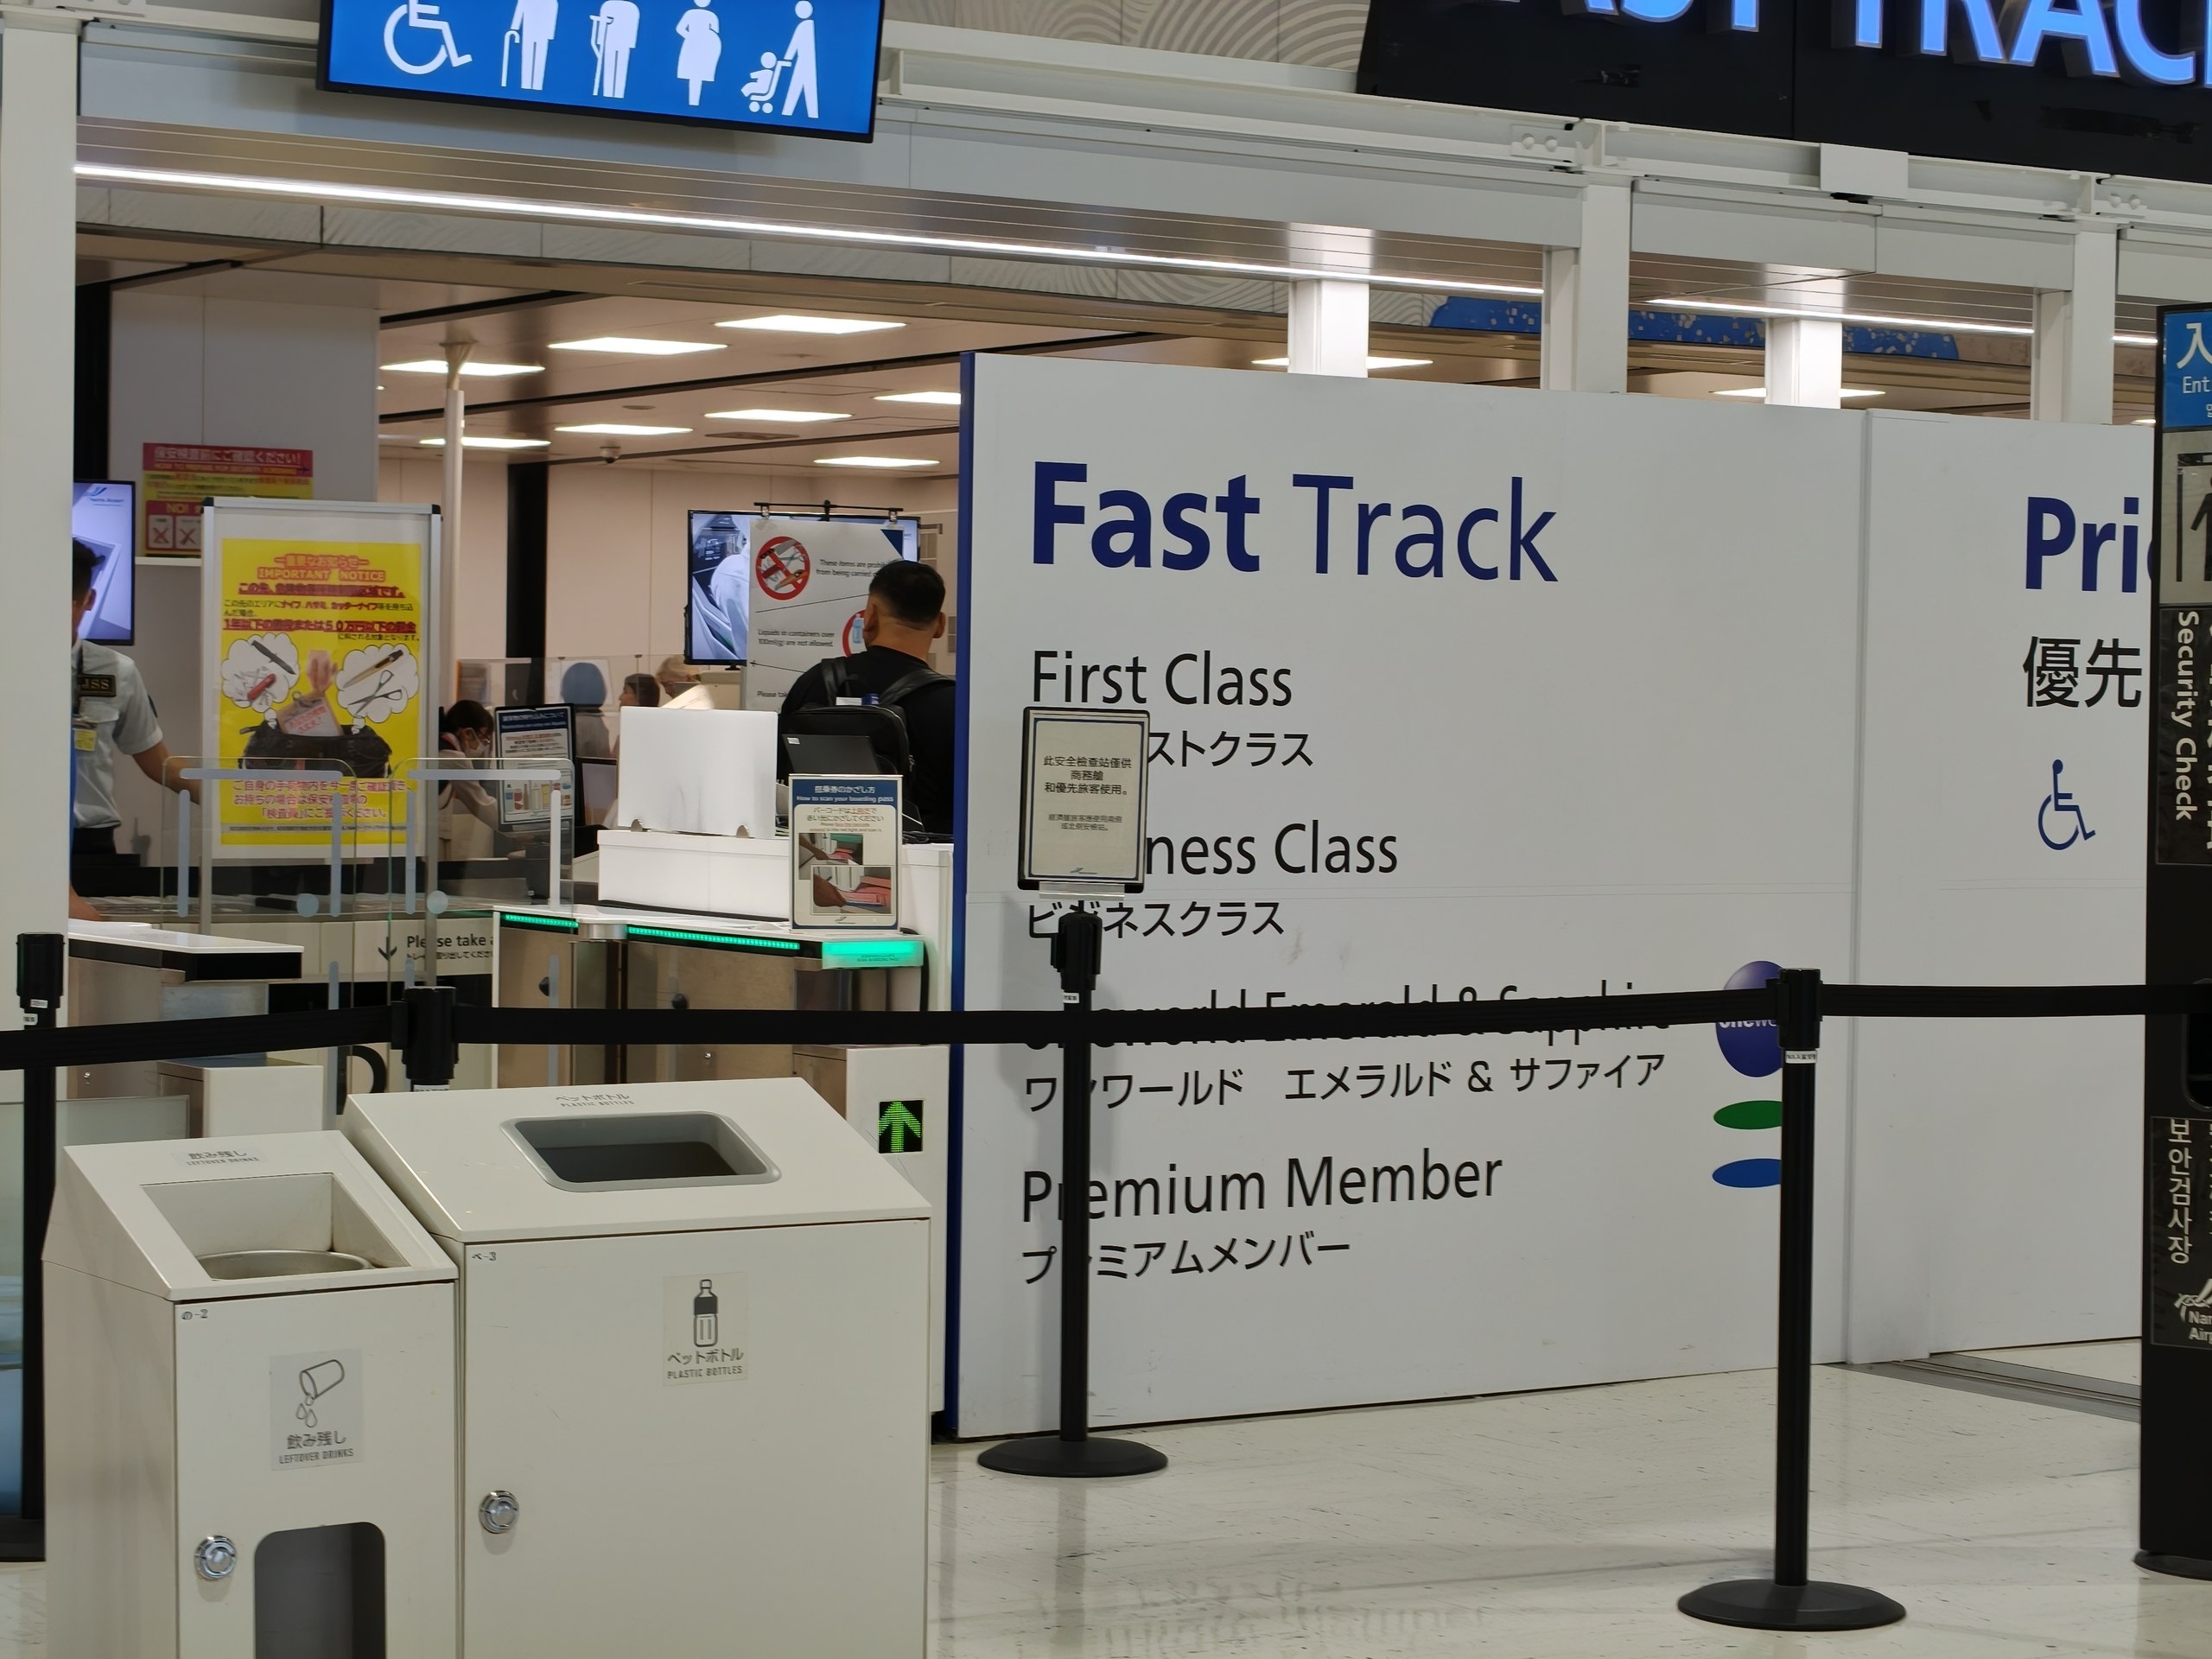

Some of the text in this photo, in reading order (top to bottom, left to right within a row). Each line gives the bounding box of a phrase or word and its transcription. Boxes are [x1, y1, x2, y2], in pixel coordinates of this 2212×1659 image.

[1033, 461, 1558, 582] Fast Track
[2025, 496, 2153, 593] Pri
[257, 567, 385, 582] IMPORTANT NOTICE
[1033, 651, 1293, 707] First Class
[2023, 636, 2142, 709] 優先
[2171, 611, 2199, 821] Security Check
[1148, 730, 1314, 767] ストクラス
[1146, 819, 1398, 874] ness Class
[407, 935, 452, 948] Plese
[456, 933, 486, 946] take
[1026, 1054, 1666, 1112] ワワールド エメラルド & サファイア
[1287, 1147, 1503, 1208] Member
[2168, 1119, 2192, 1264] 보안검사장
[1022, 1230, 1350, 1284] プミアムメンバー
[667, 1347, 744, 1365] ペットボトル
[667, 1365, 743, 1379] PLASTIC BOTTLES
[279, 1447, 354, 1465] LEFTOVER DRINKS
[287, 1430, 346, 1450] 飲み残し
